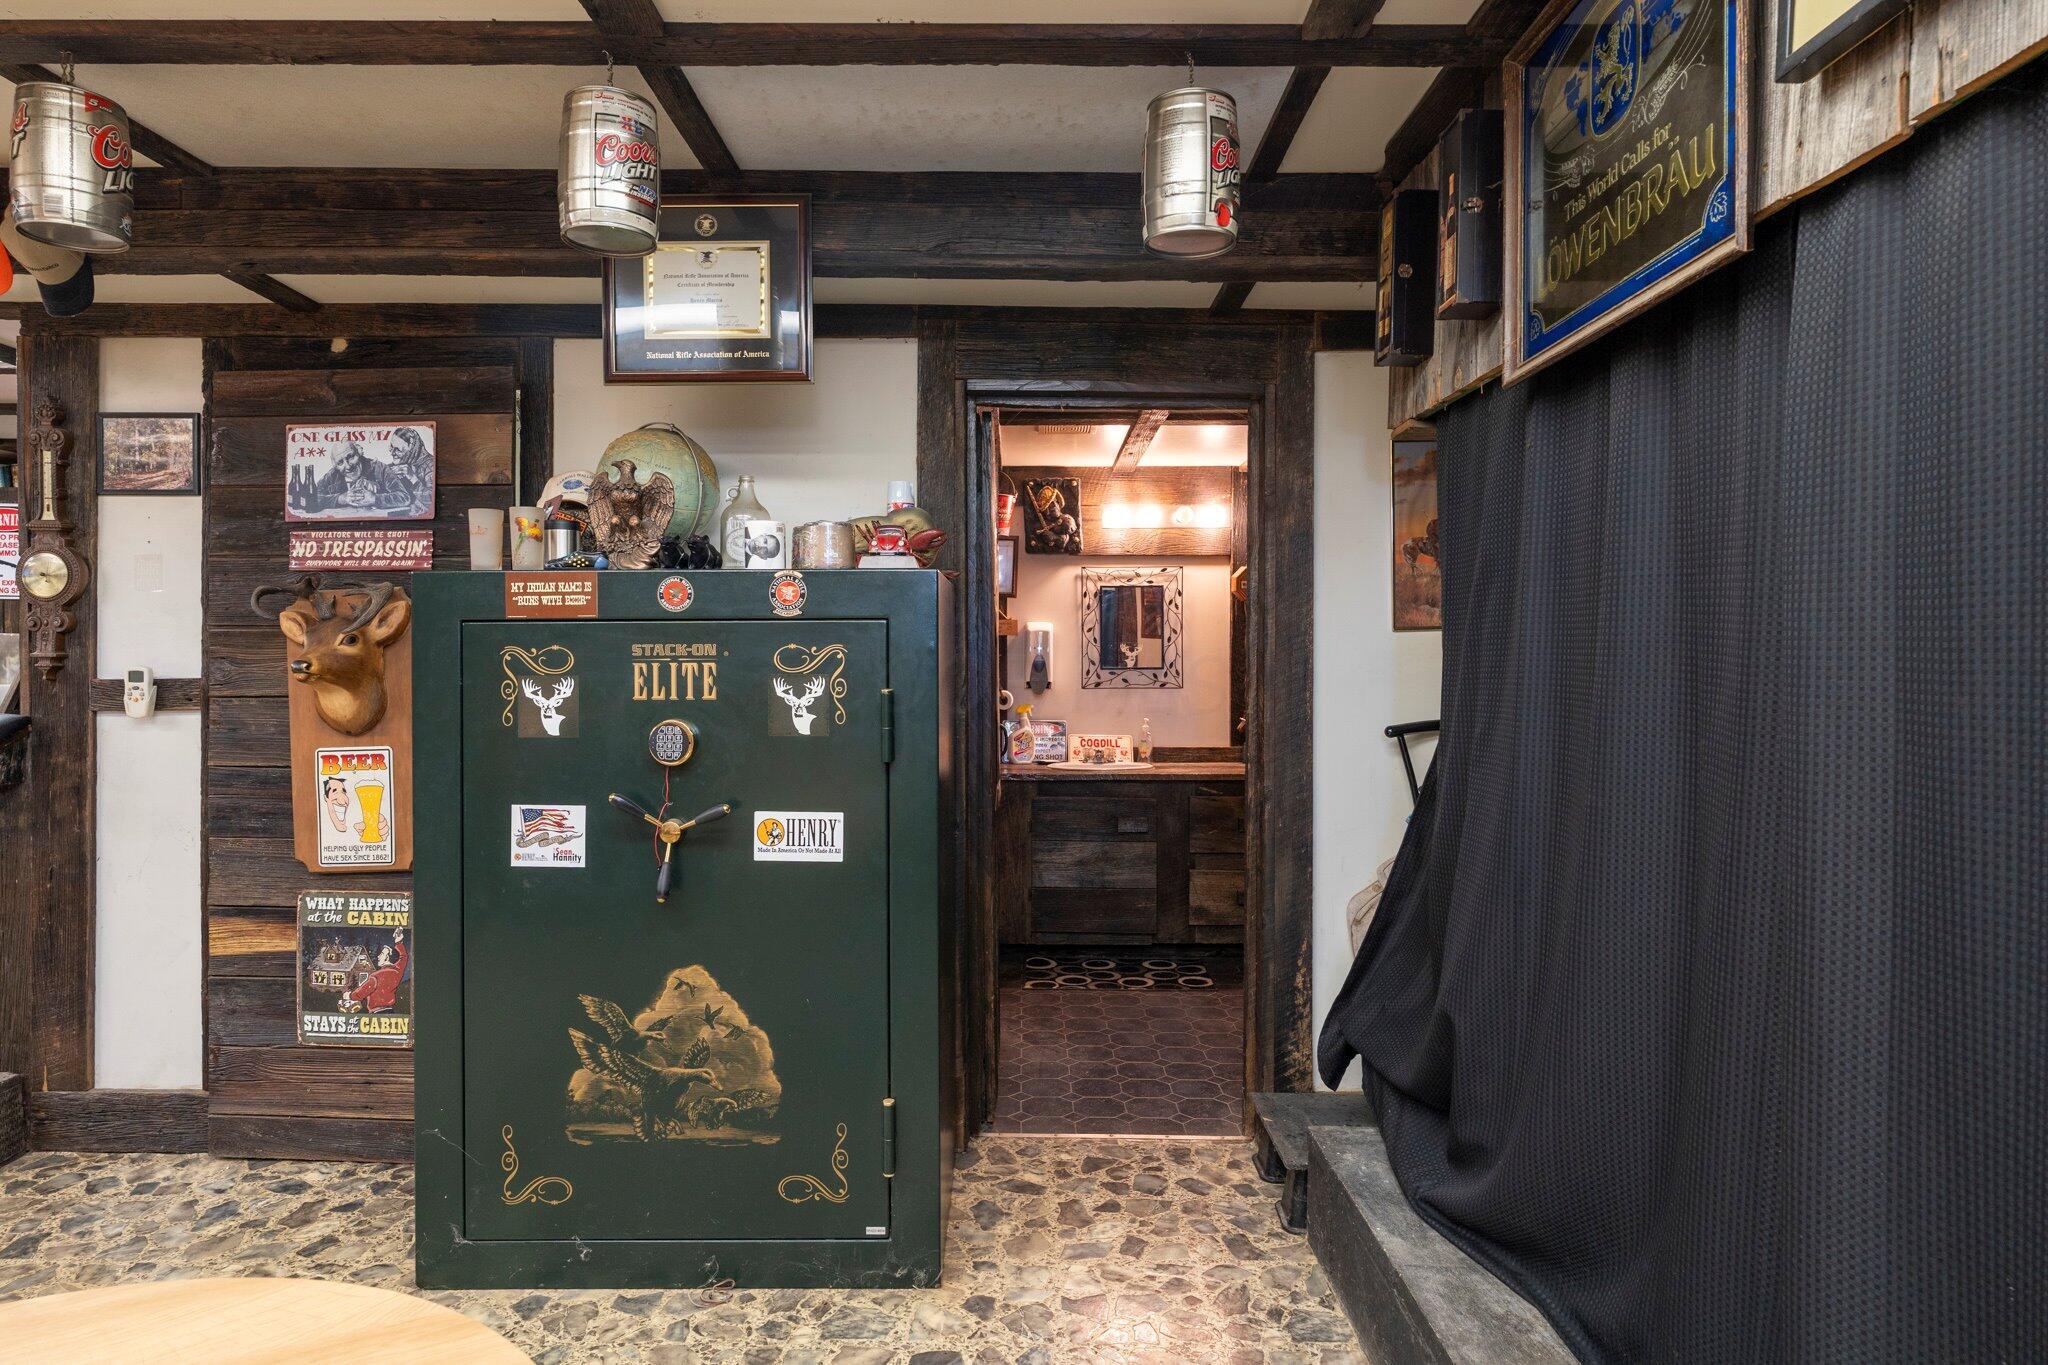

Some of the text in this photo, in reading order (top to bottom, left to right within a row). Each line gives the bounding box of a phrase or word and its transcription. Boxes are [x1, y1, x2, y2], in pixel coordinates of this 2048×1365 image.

[595, 133, 658, 167] Coors
[600, 161, 657, 185] LIGHT
[1564, 122, 1672, 222] This World Calls for
[646, 350, 770, 359] National Rifle Association of America
[290, 432, 320, 442] ONE
[324, 431, 366, 443] GLASS
[311, 531, 351, 539] VIOLATORS
[293, 541, 317, 558] NO
[510, 582, 592, 592] MY INDIAN NAME IS
[660, 577, 681, 593] NATIONAL
[770, 575, 794, 593] NATIONAL
[541, 595, 563, 605] WITH
[661, 598, 690, 610] ASSOCIATION
[771, 597, 804, 610] ASSOCIATION
[631, 643, 717, 656] STACK-ON
[632, 662, 717, 700] ELITE
[1080, 738, 1121, 748] COGDILL
[320, 753, 388, 775] BEER
[785, 818, 838, 847] HENRY
[553, 852, 582, 863] Hannity
[555, 847, 573, 855] Sean
[305, 896, 410, 911] WHAT HAPPENS
[307, 911, 409, 926] at the CABIN
[303, 1015, 409, 1034] STAYS at CABIN
[347, 1024, 359, 1033] the
